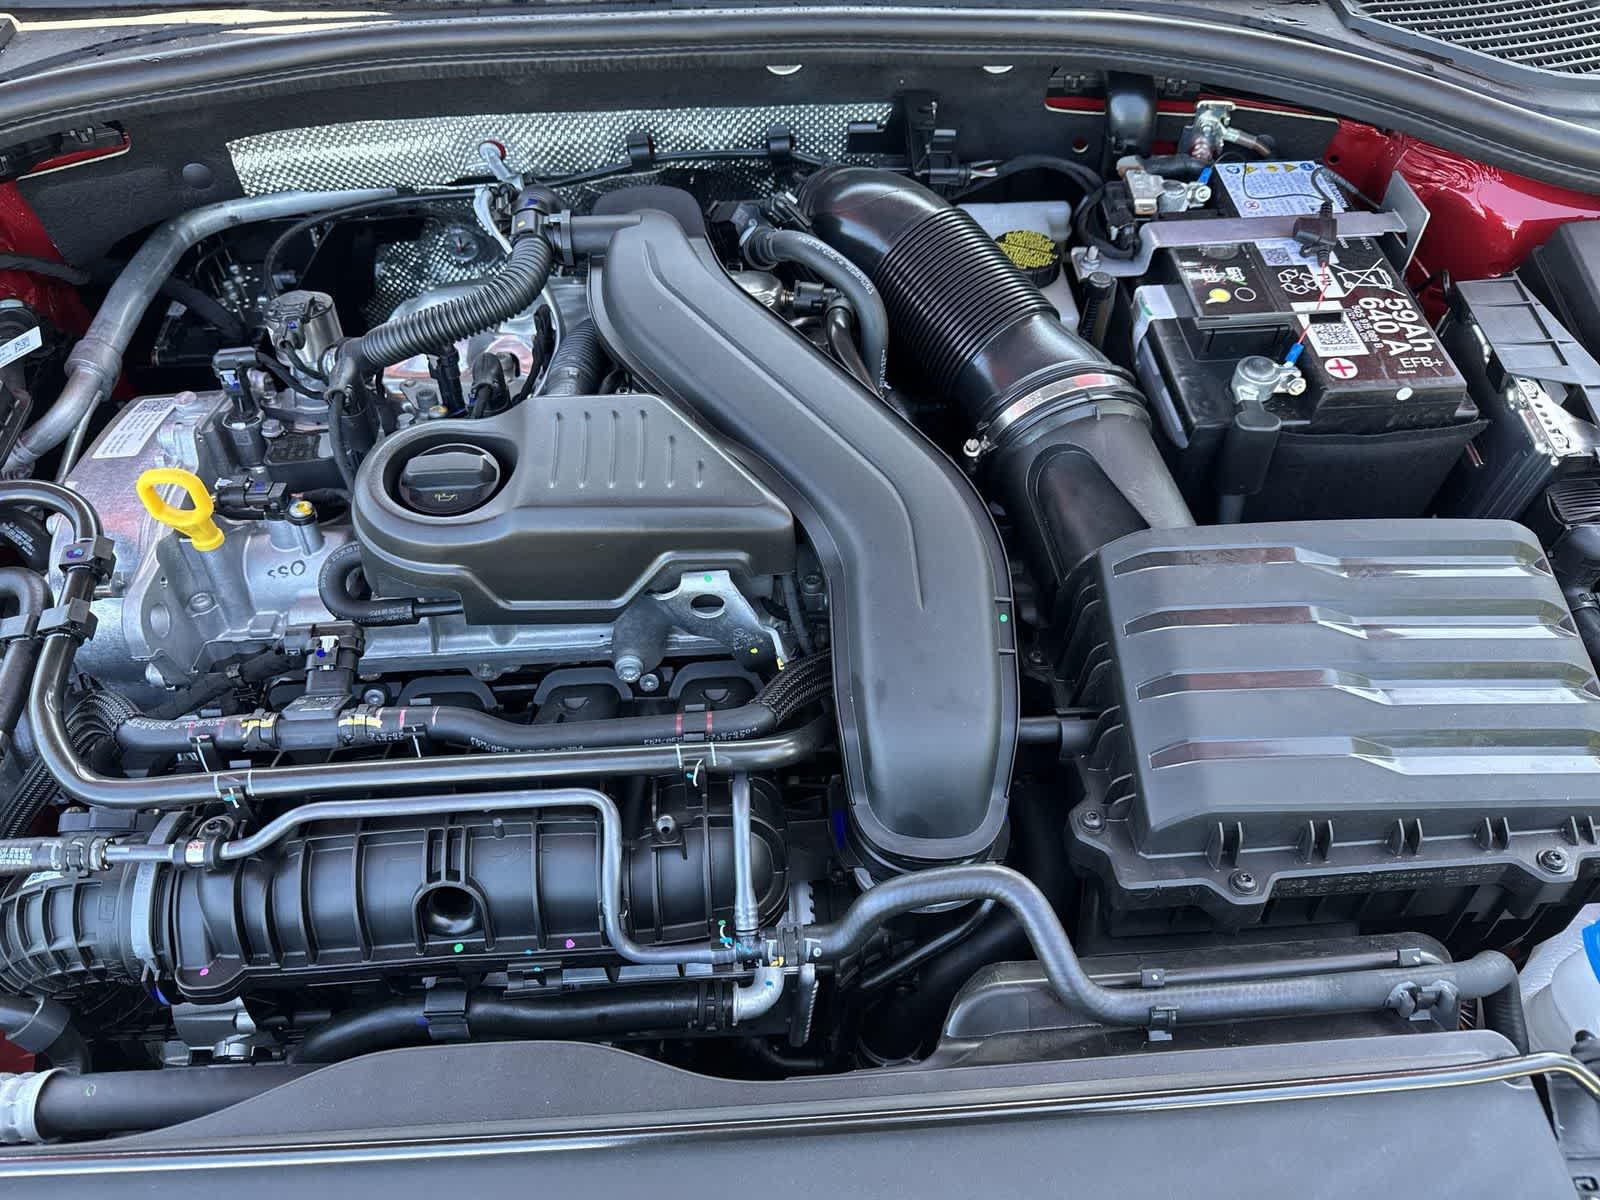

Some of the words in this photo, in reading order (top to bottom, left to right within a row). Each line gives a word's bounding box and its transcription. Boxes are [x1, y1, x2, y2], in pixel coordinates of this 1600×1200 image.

[1358, 297, 1401, 334] 640
[1382, 339, 1412, 356] A
[1385, 298, 1435, 352] 59Ah
[1400, 356, 1444, 369] EFB+
